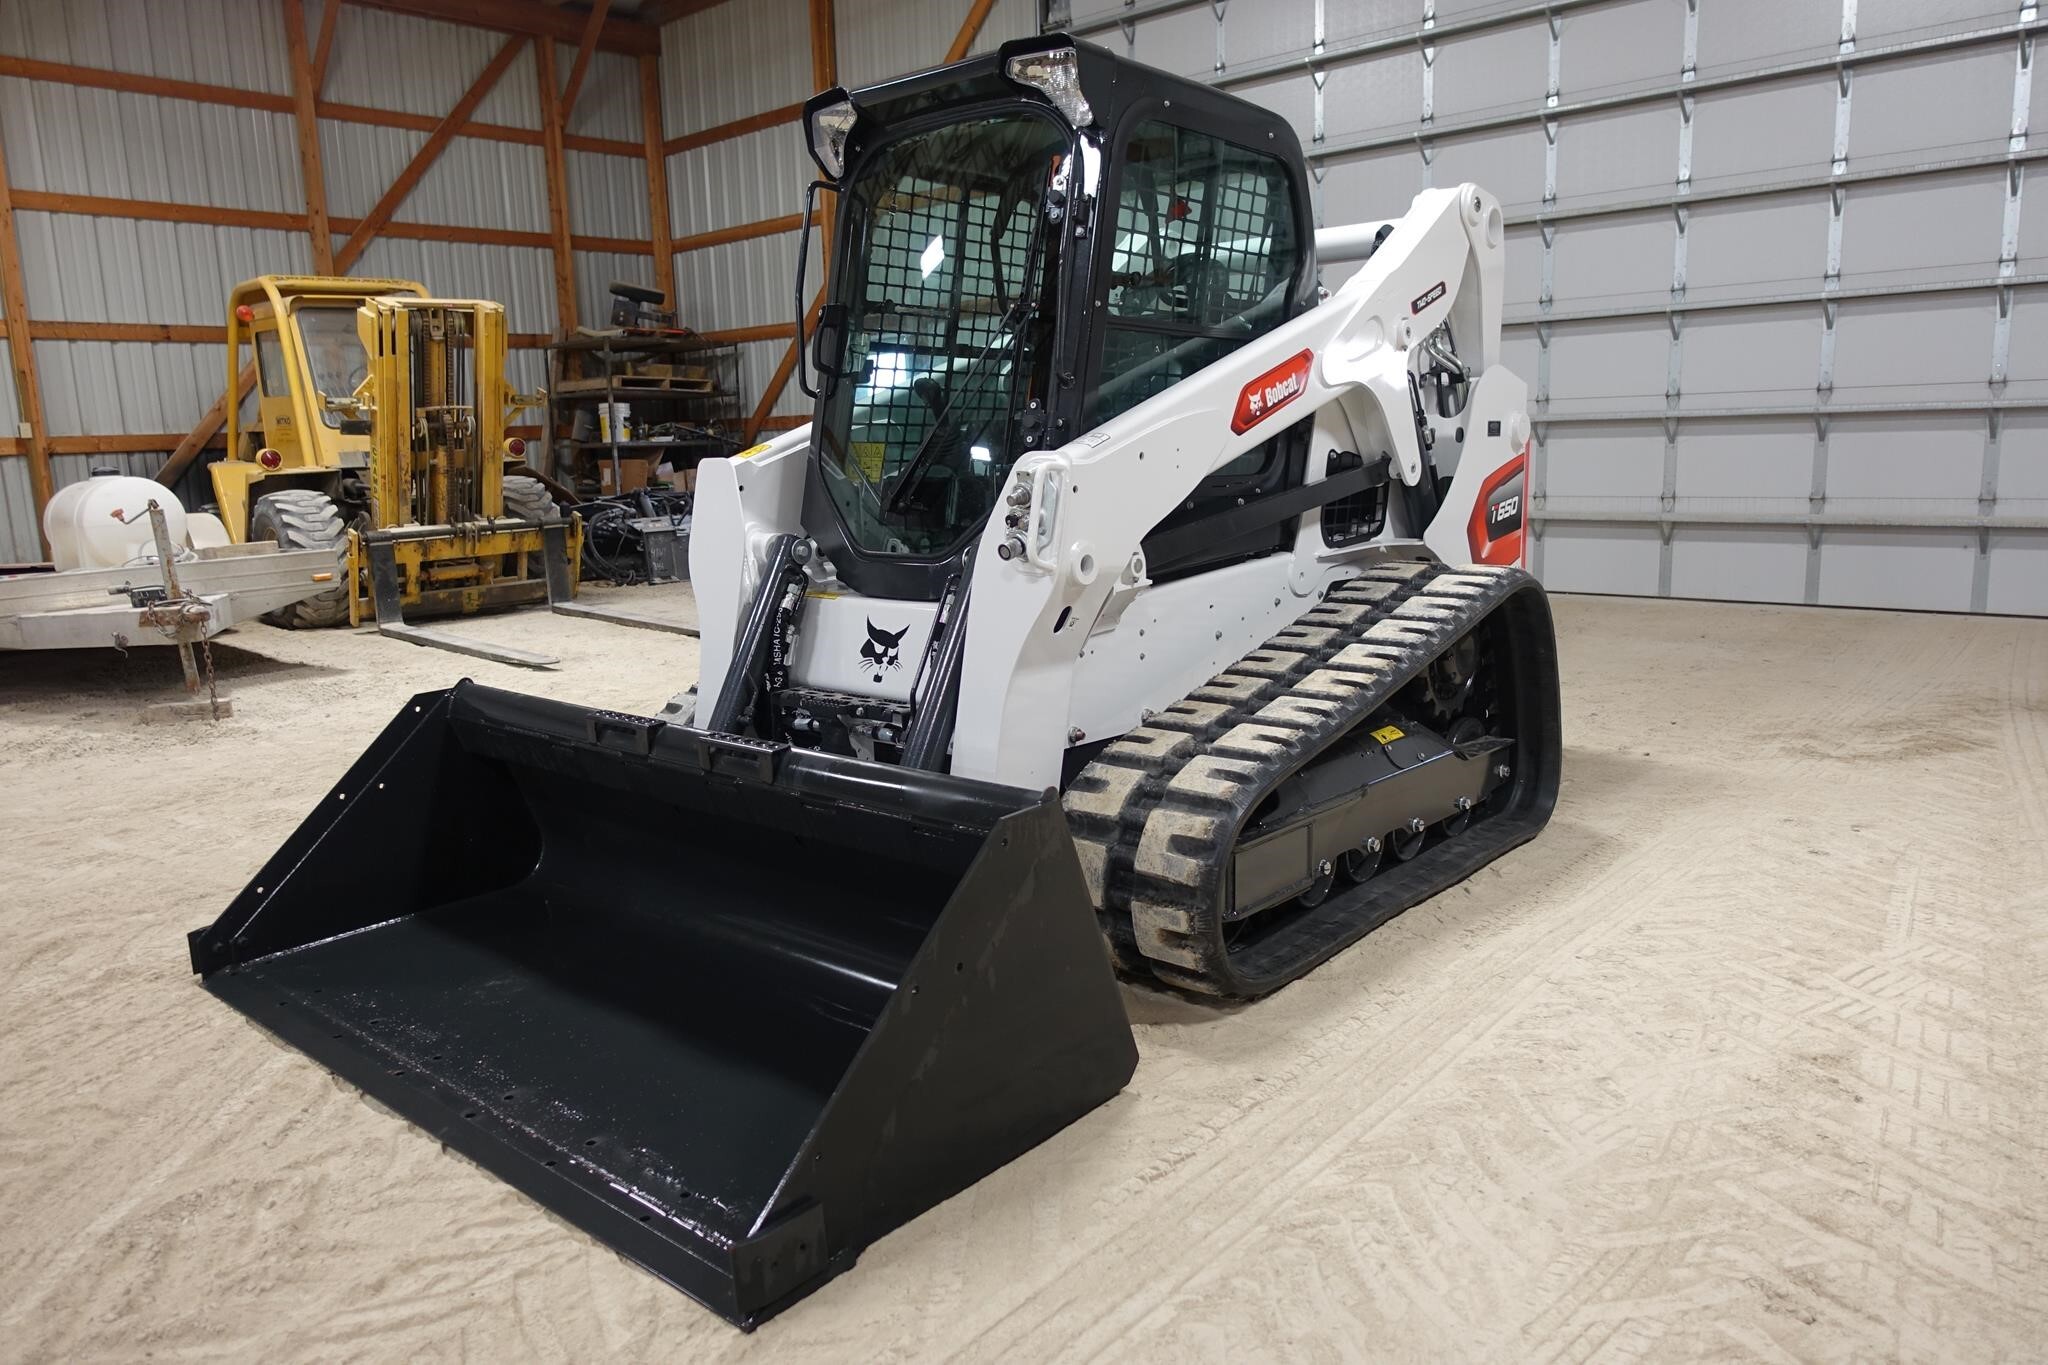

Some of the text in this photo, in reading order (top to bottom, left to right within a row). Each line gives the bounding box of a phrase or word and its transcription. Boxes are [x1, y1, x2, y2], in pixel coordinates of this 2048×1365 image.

[1417, 285, 1443, 309] TWO-SPEED
[1264, 373, 1299, 408] Bobcat
[1491, 495, 1519, 524] T650
